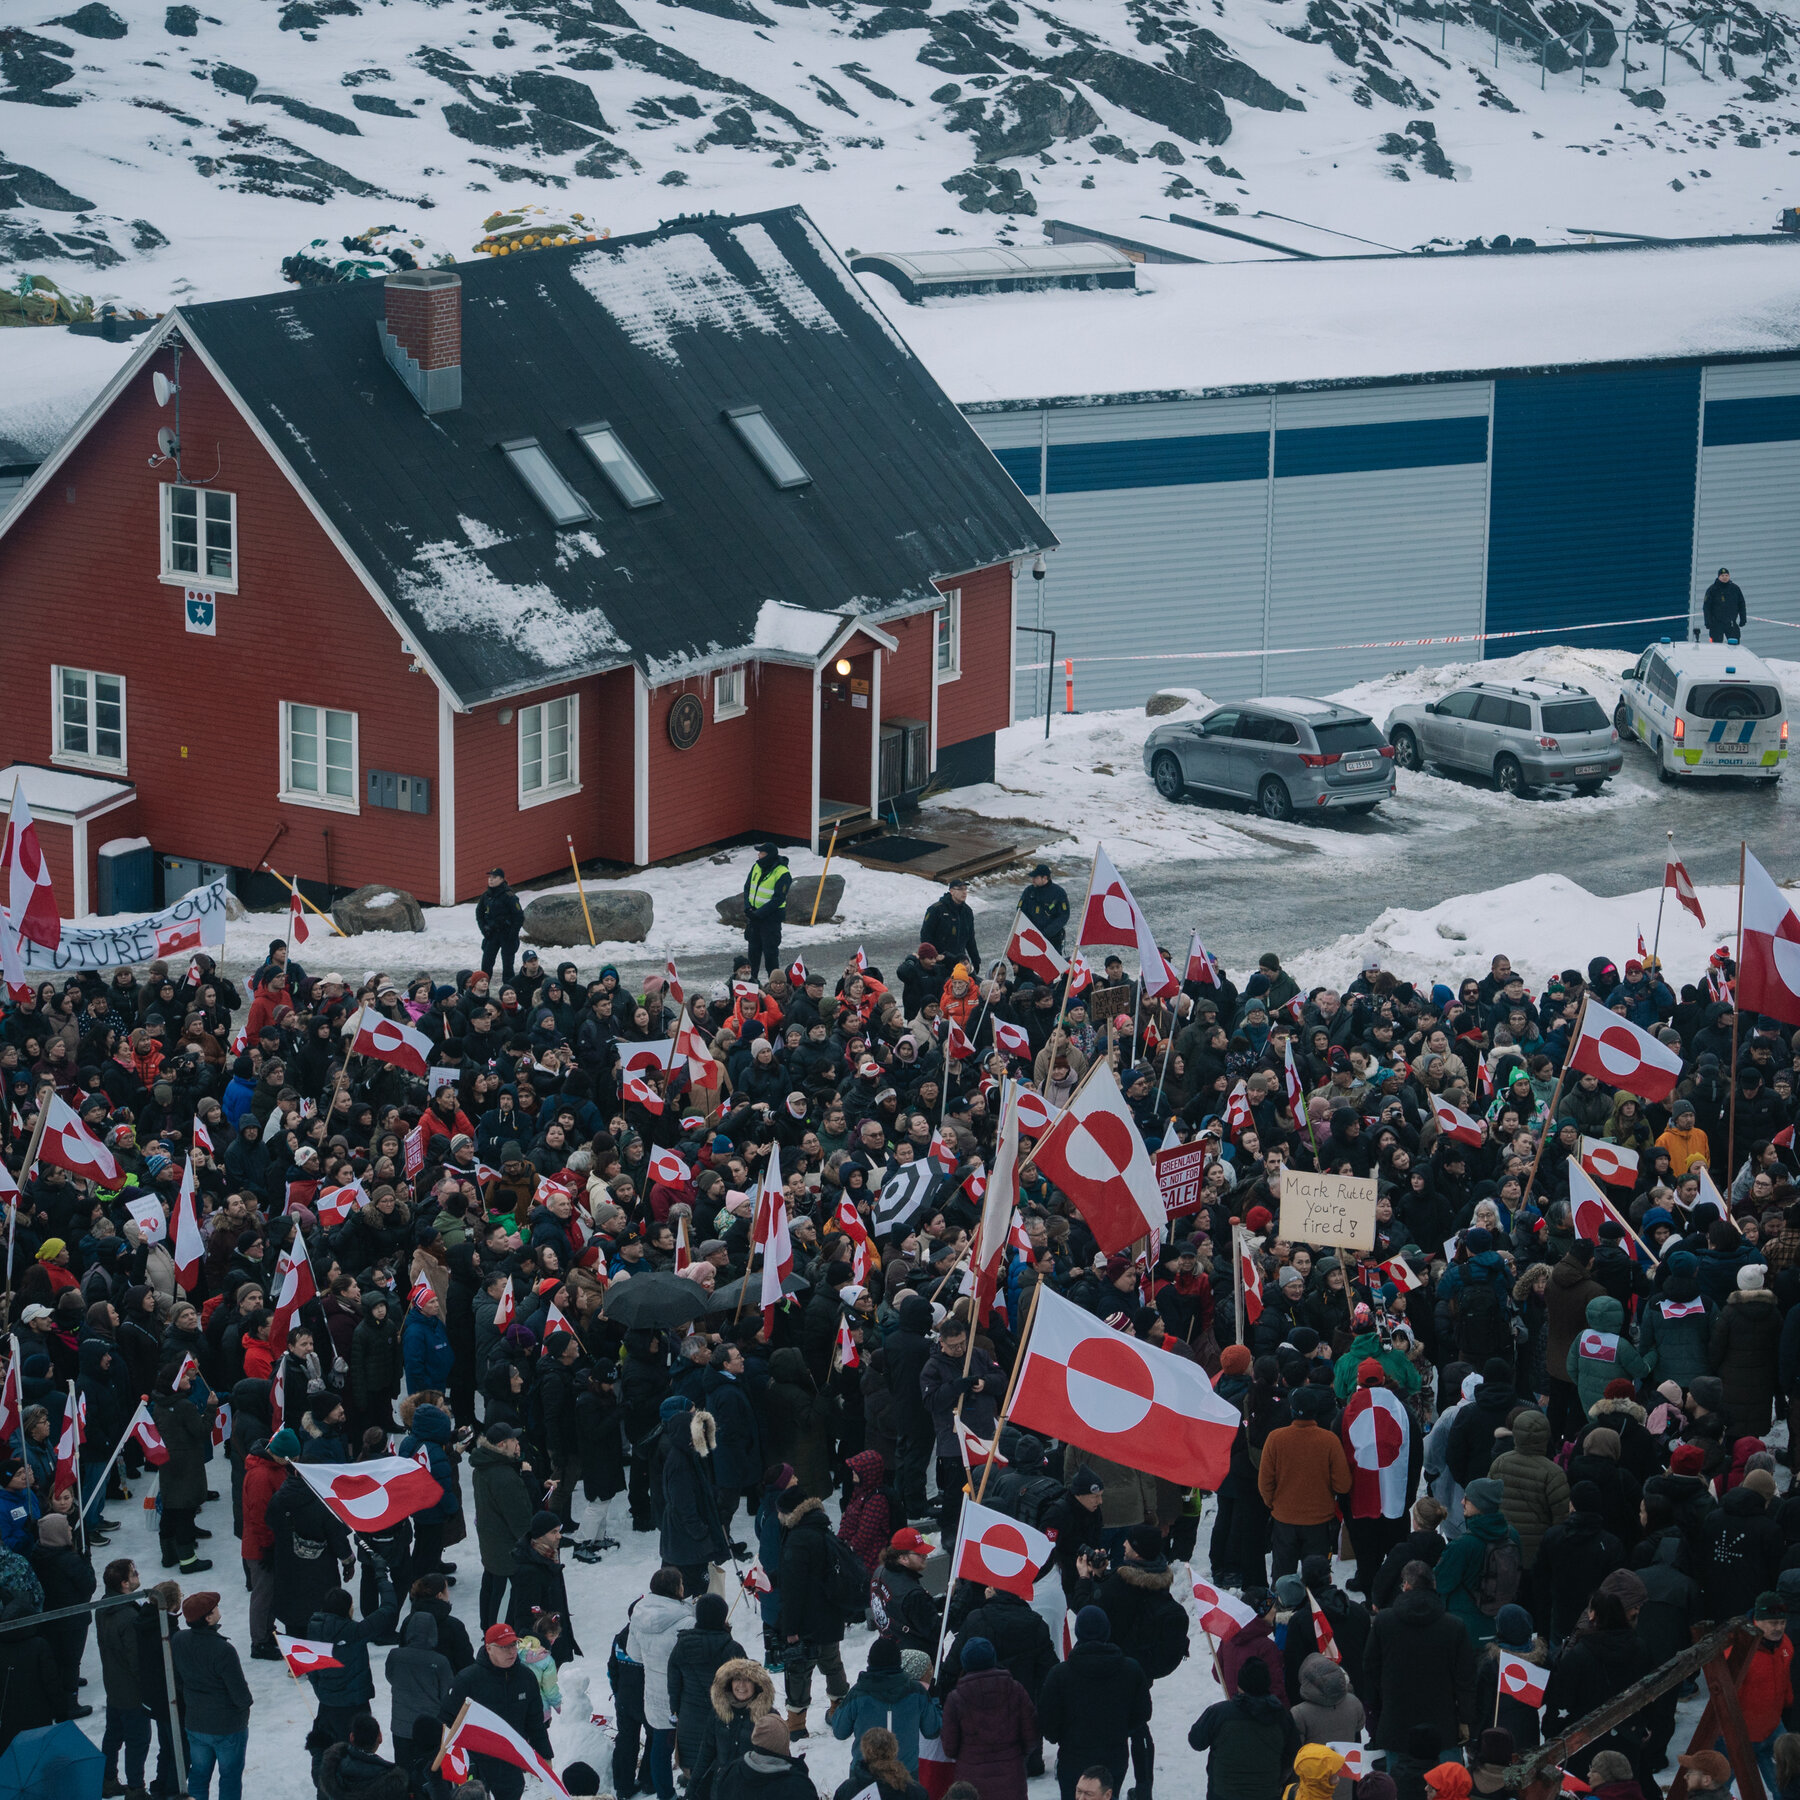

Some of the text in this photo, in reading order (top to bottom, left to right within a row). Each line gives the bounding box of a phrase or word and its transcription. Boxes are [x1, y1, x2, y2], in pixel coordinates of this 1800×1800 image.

[172, 882, 227, 921] OUR
[26, 934, 154, 969] FUTURE
[1162, 1152, 1199, 1173] GREENLAND
[1160, 1167, 1199, 1188] IS NOT FOR
[1286, 1177, 1374, 1202] Mark Rutte
[1161, 1182, 1198, 1209] SALE!
